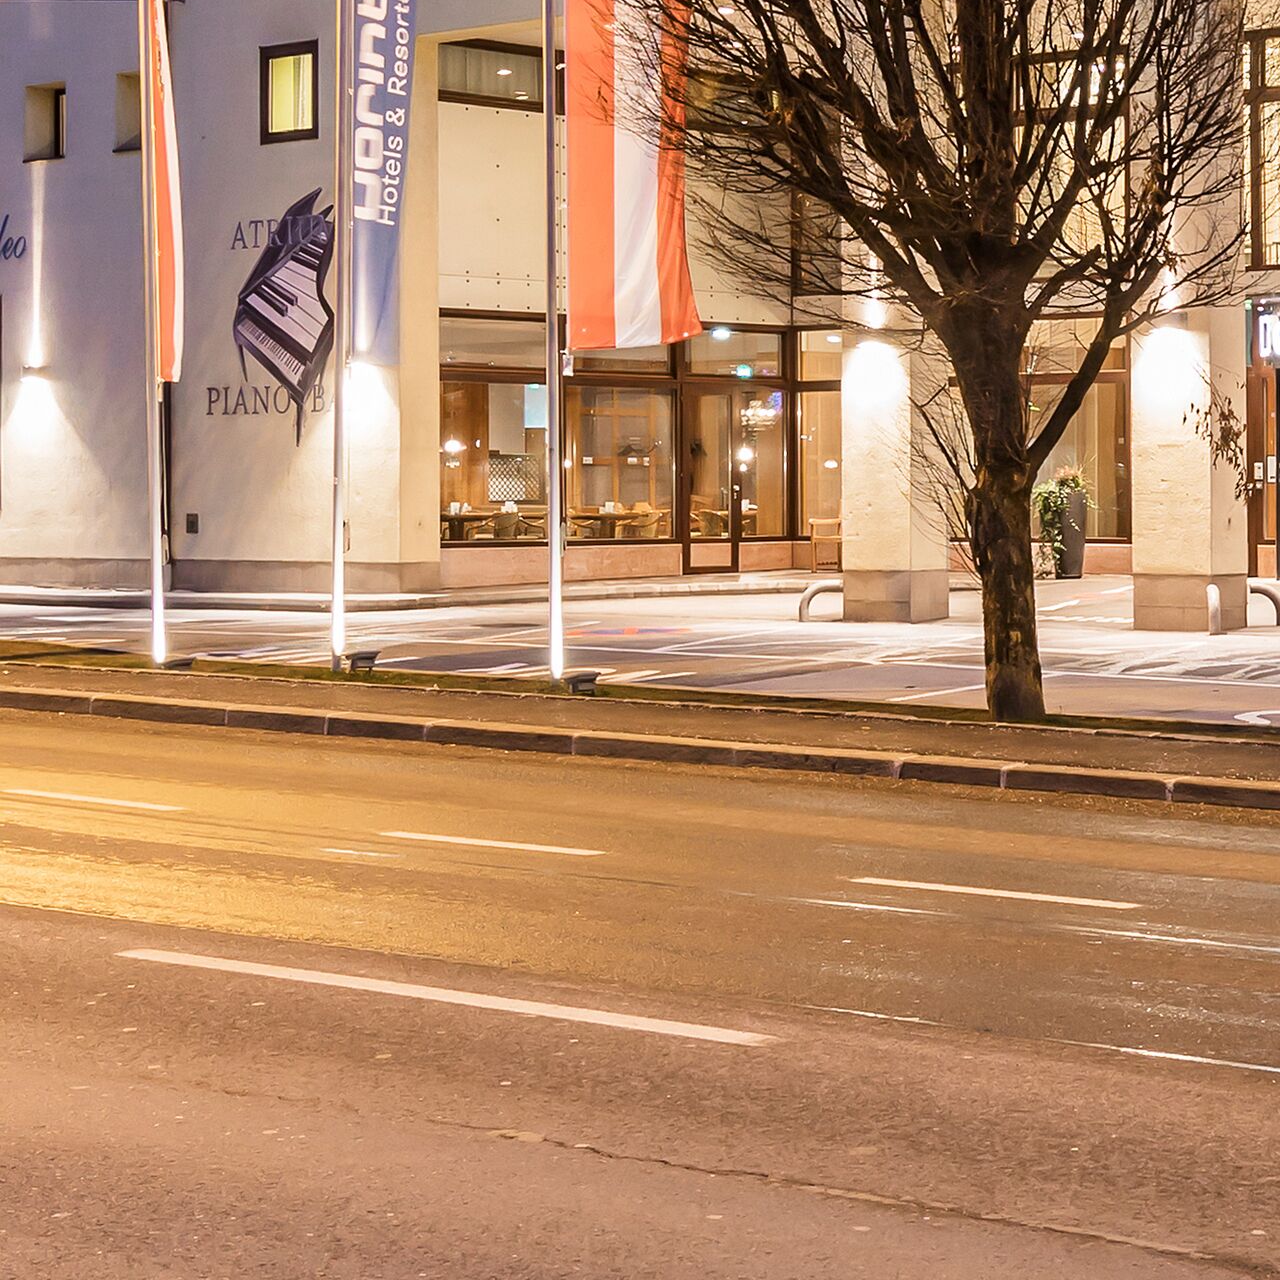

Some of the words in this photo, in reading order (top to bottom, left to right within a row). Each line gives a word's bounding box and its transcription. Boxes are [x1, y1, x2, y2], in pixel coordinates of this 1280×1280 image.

[385, 107, 406, 127] &
[376, 134, 404, 226] Hotels
[206, 383, 292, 416] PIANO
